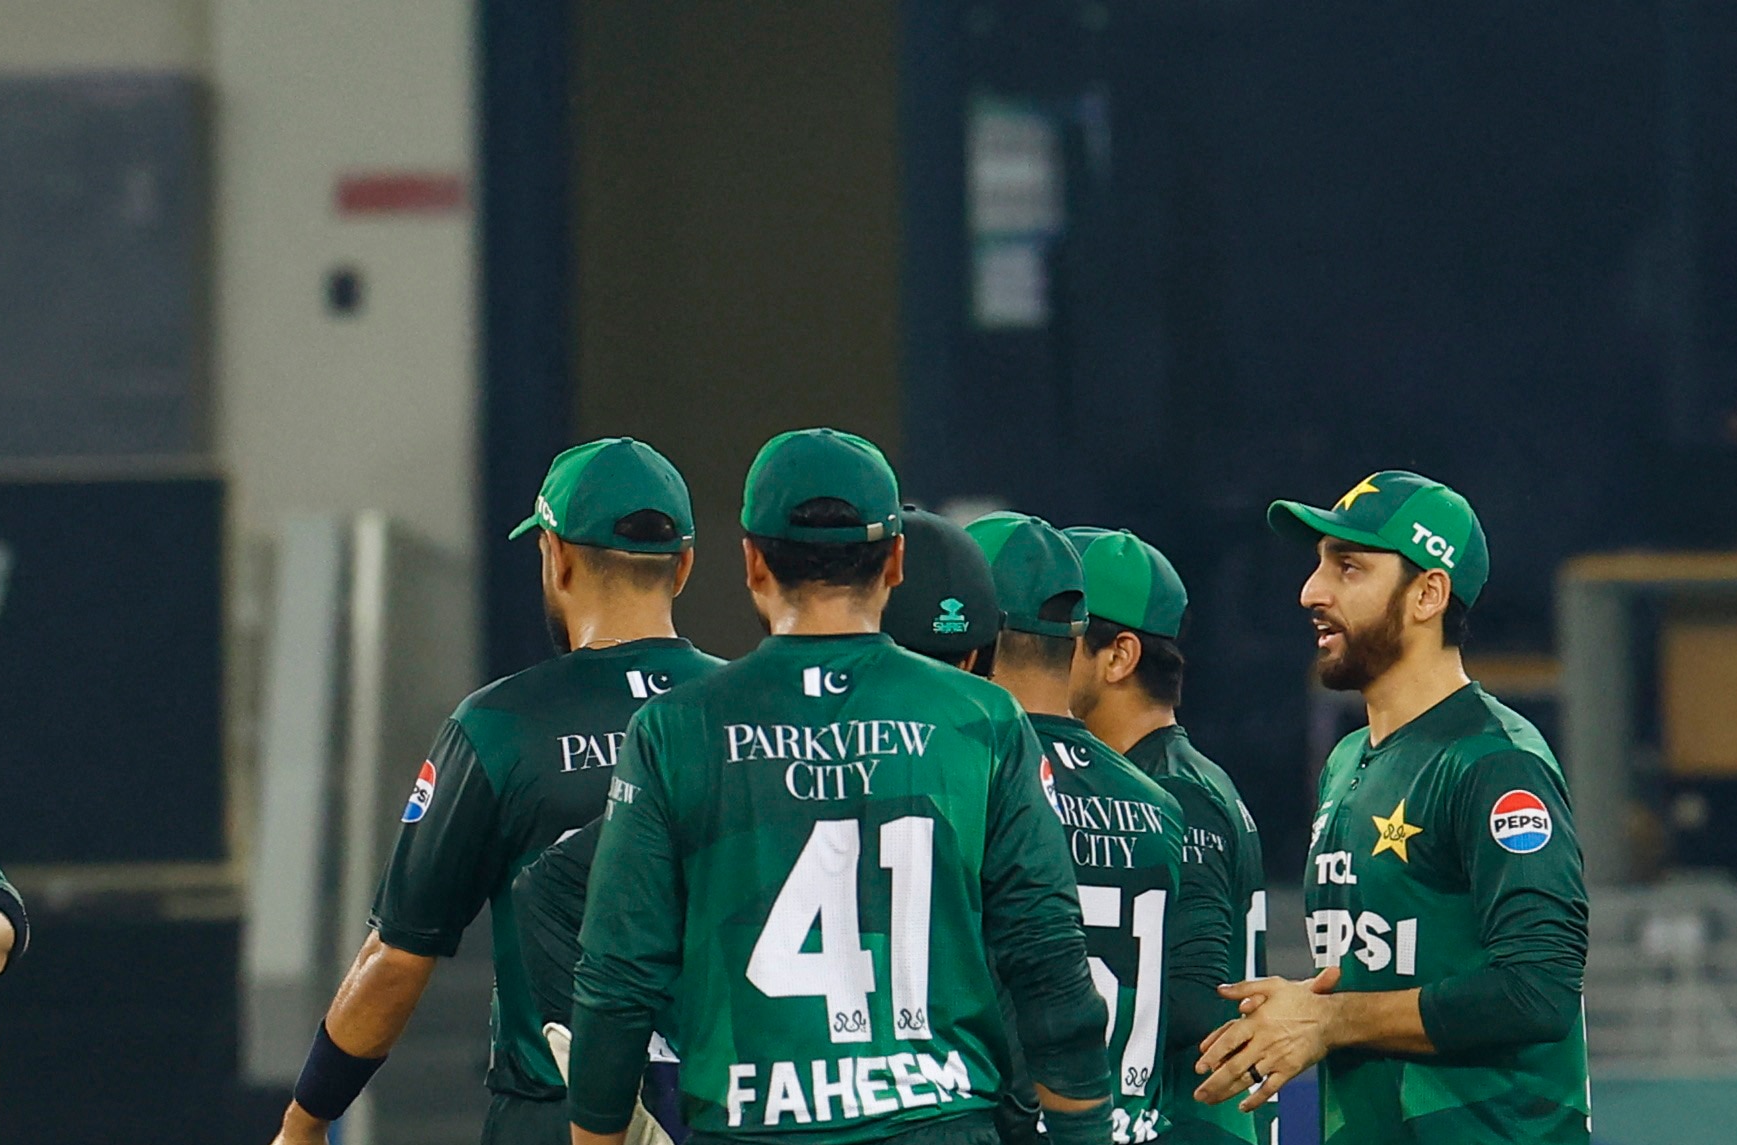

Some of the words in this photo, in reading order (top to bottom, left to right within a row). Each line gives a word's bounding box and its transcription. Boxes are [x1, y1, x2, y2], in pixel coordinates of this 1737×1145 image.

[1411, 521, 1455, 569] TCL
[723, 719, 937, 763] PARKVIEW
[785, 758, 880, 800] CITY
[1056, 793, 1164, 834] RKVIEW
[1494, 814, 1549, 833] PEPSI
[1071, 829, 1138, 869] CITY
[1315, 851, 1357, 885] TCL
[746, 816, 935, 1043] 41
[727, 1050, 972, 1127] FAHEEM
